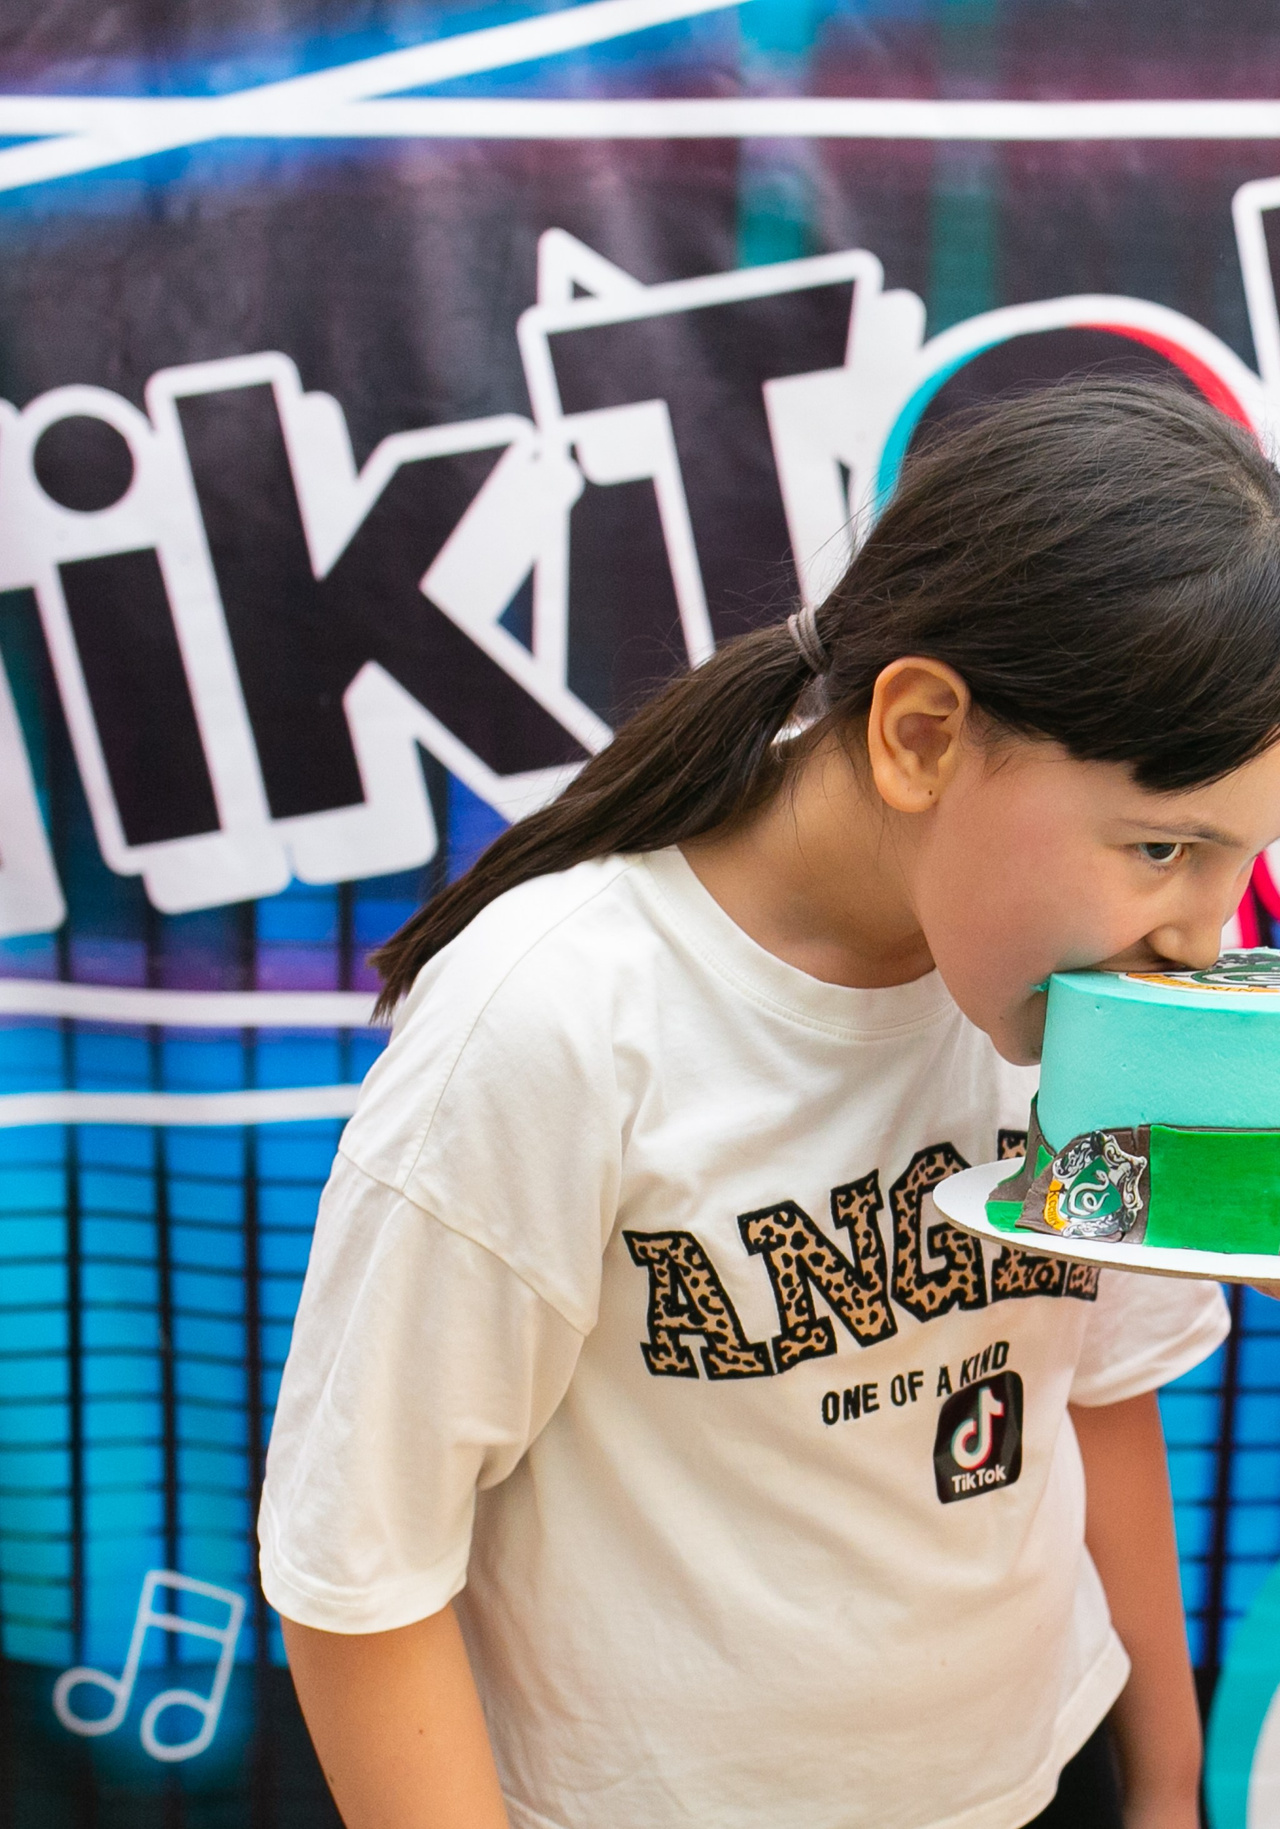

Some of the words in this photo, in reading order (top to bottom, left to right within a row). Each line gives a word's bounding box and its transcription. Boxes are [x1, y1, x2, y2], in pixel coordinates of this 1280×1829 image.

[821, 1382, 880, 1426] ONE
[890, 1370, 924, 1407] OF
[936, 1365, 952, 1397] A
[960, 1340, 1010, 1388] KIND
[951, 1464, 1007, 1493] TikTok
